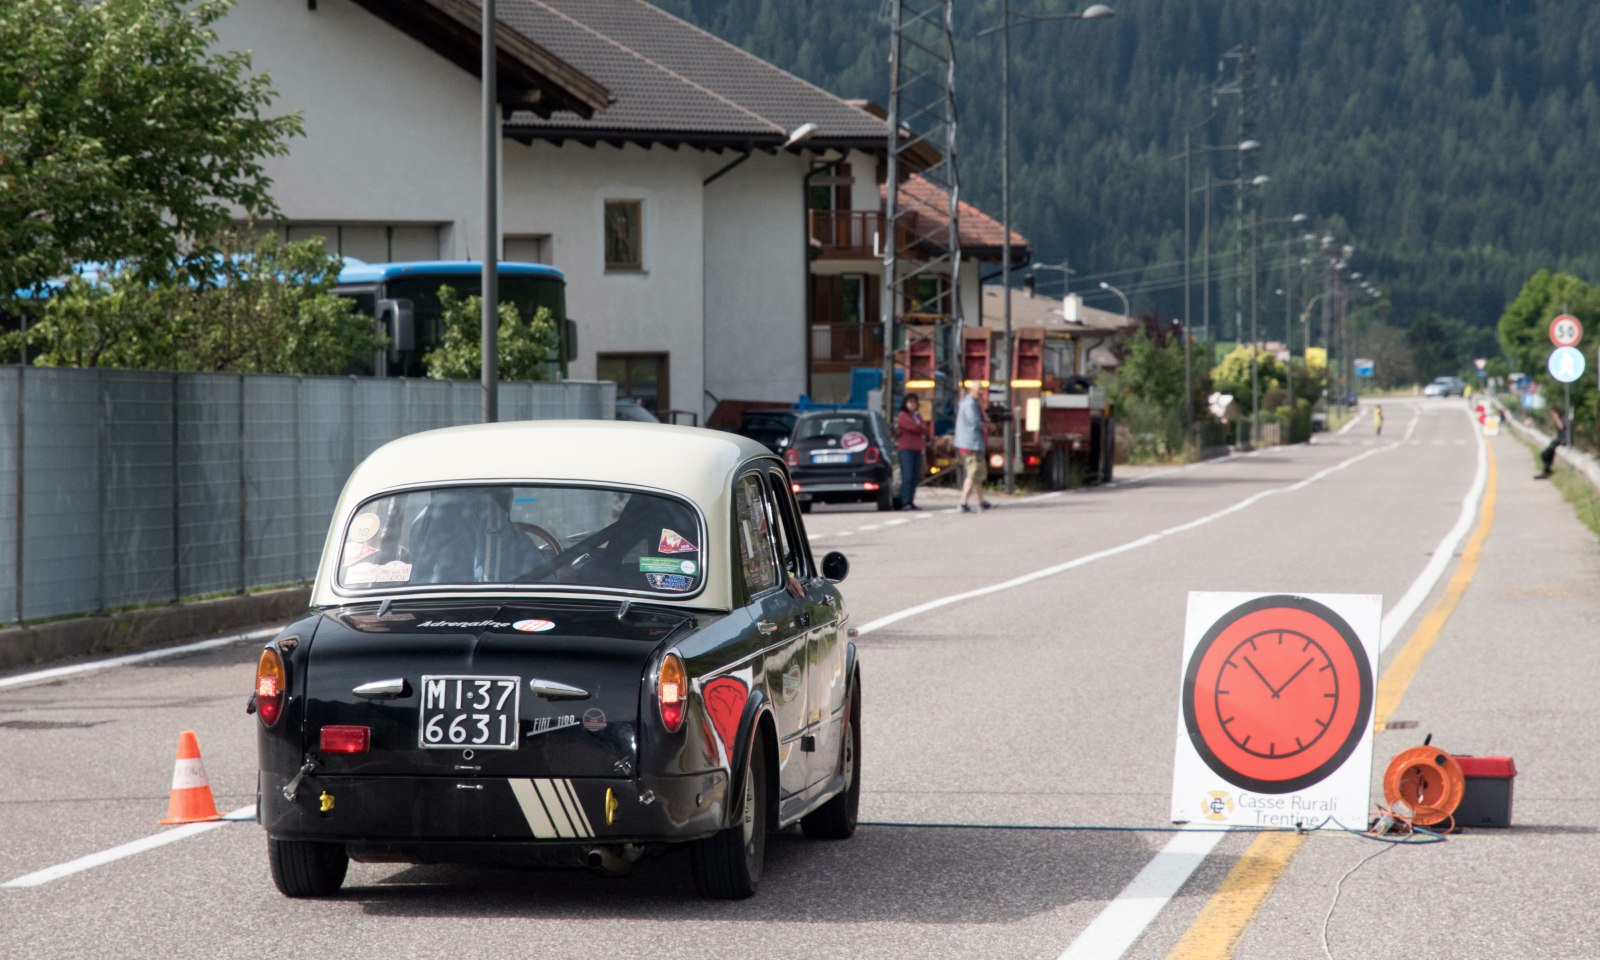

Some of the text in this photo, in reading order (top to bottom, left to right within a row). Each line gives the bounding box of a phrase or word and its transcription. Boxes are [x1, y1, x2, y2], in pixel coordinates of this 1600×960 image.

[1558, 325, 1576, 338] 50
[416, 619, 511, 628] Adrenaline
[425, 713, 507, 745] 6631
[532, 717, 552, 732] FIAT
[1238, 793, 1338, 812] Casse Rurali
